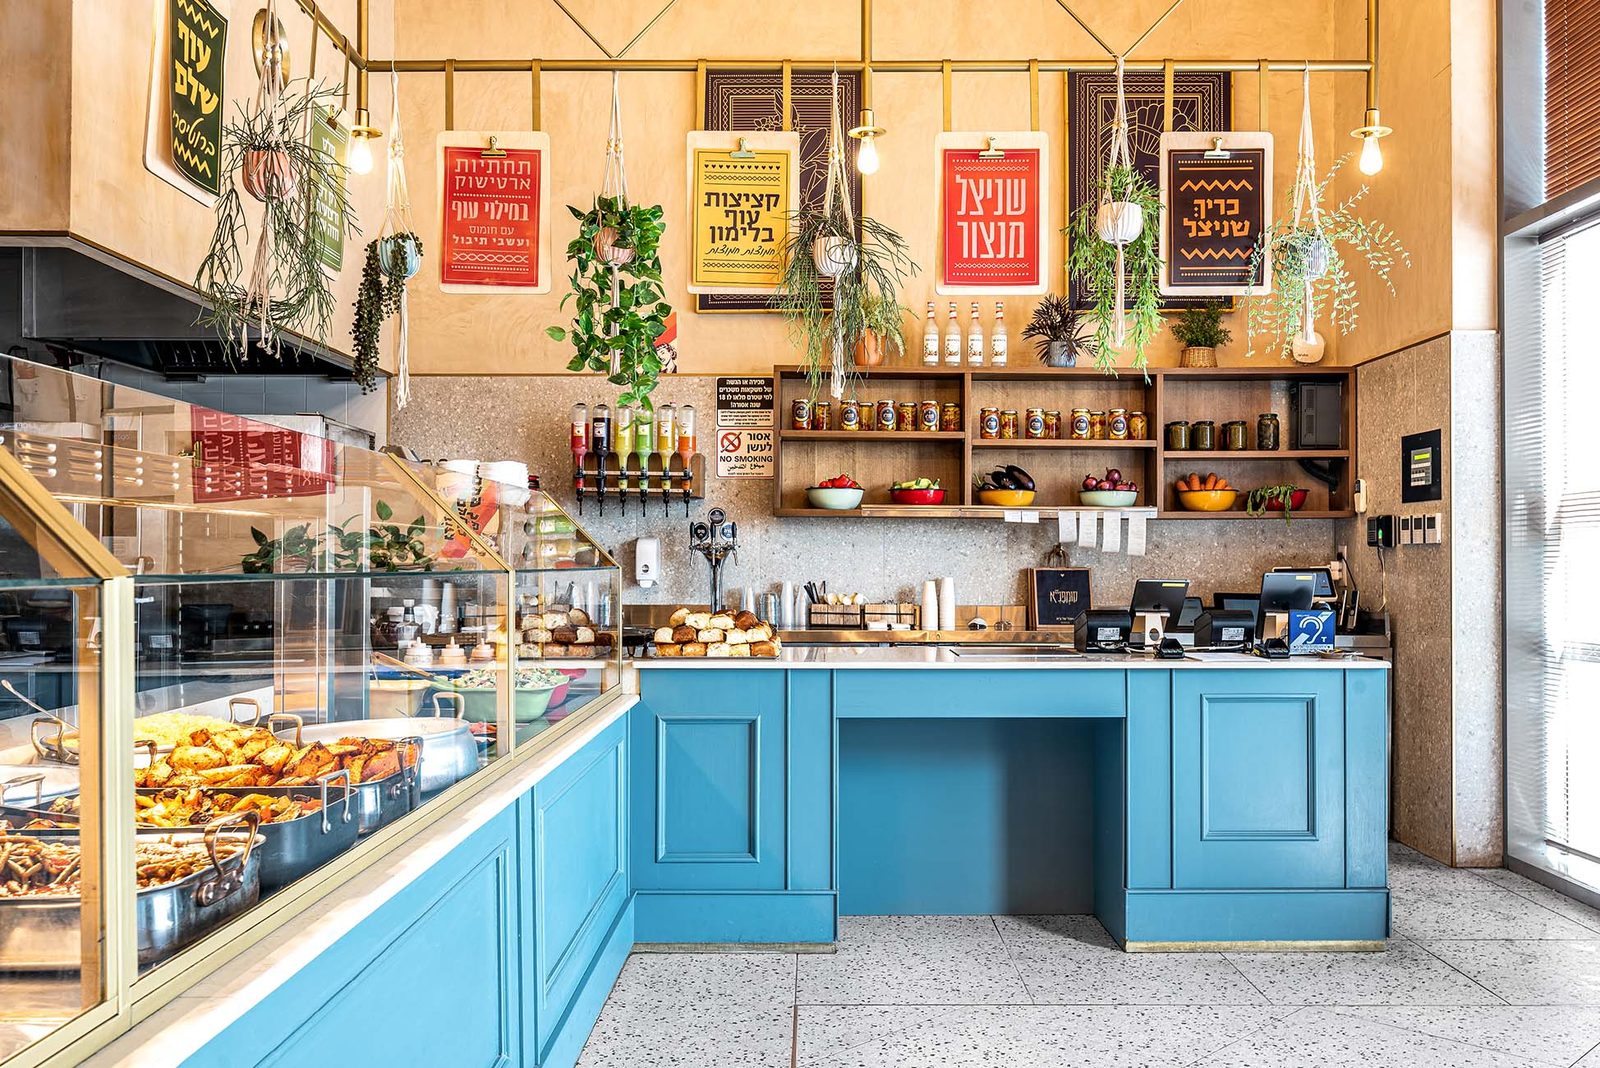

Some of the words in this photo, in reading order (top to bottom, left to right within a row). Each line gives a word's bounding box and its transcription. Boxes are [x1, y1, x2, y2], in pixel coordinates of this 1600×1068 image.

[178, 17, 211, 73] עוף
[175, 59, 219, 115] שלם
[455, 158, 531, 175] תחתיות
[455, 175, 531, 190] ארטישוק
[704, 191, 780, 212] קציצות
[955, 174, 1027, 216] שניצל
[452, 200, 479, 221] עוף
[484, 200, 529, 221] במילוי
[724, 209, 760, 228] עוף
[469, 225, 497, 235] חומוס
[500, 226, 515, 235] עם
[709, 225, 774, 244] בלימון
[1182, 217, 1250, 238] שניצל
[452, 234, 488, 245] תיבול
[492, 236, 530, 247] ועשבי
[956, 221, 1025, 258] מנצור
[747, 432, 771, 440] אסור
[747, 442, 772, 453] לעשן
